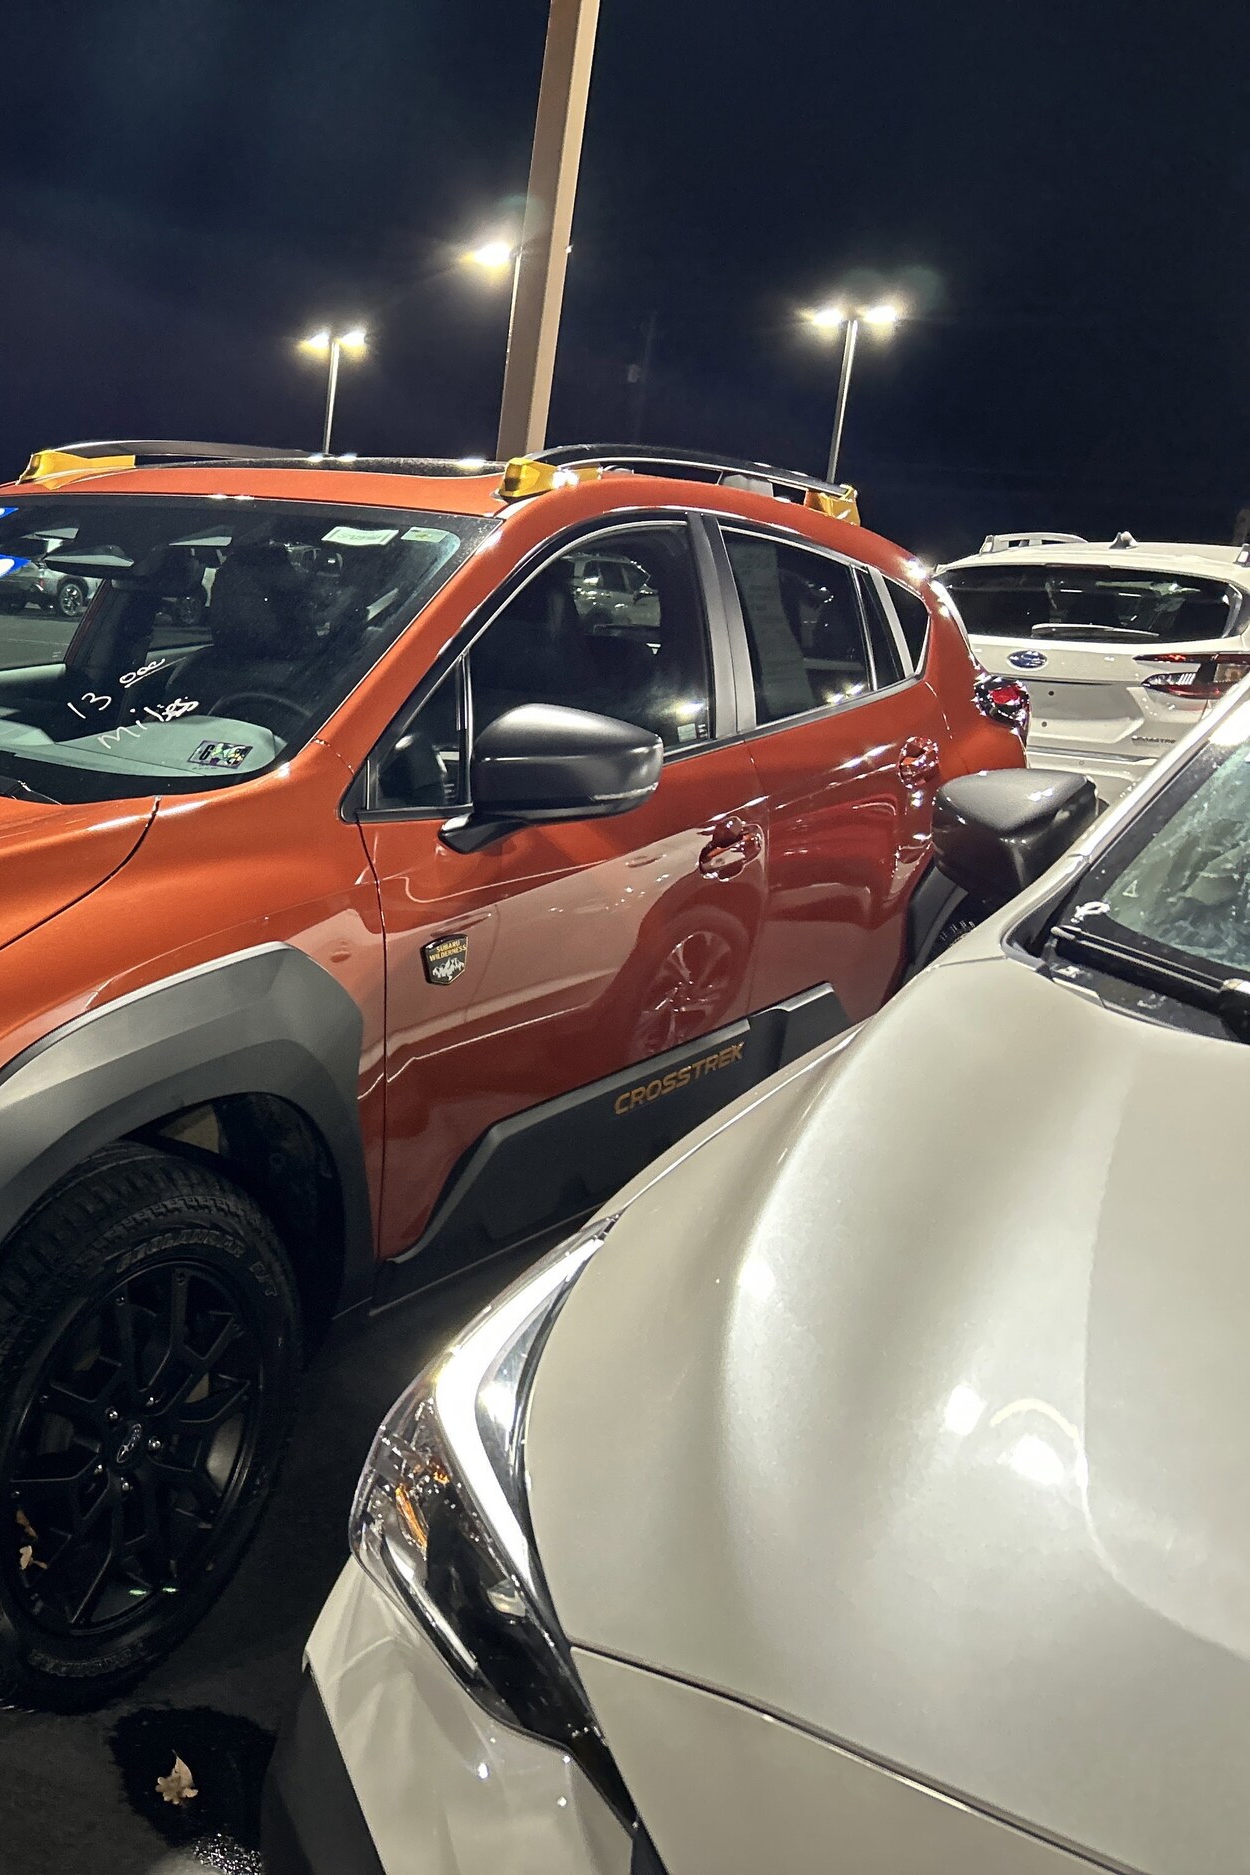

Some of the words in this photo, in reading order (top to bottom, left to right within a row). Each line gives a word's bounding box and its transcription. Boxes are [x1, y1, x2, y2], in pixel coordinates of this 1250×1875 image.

[67, 692, 112, 719] 13
[429, 944, 467, 962] WILDERNESS
[614, 1041, 745, 1115] CROSSTREK
